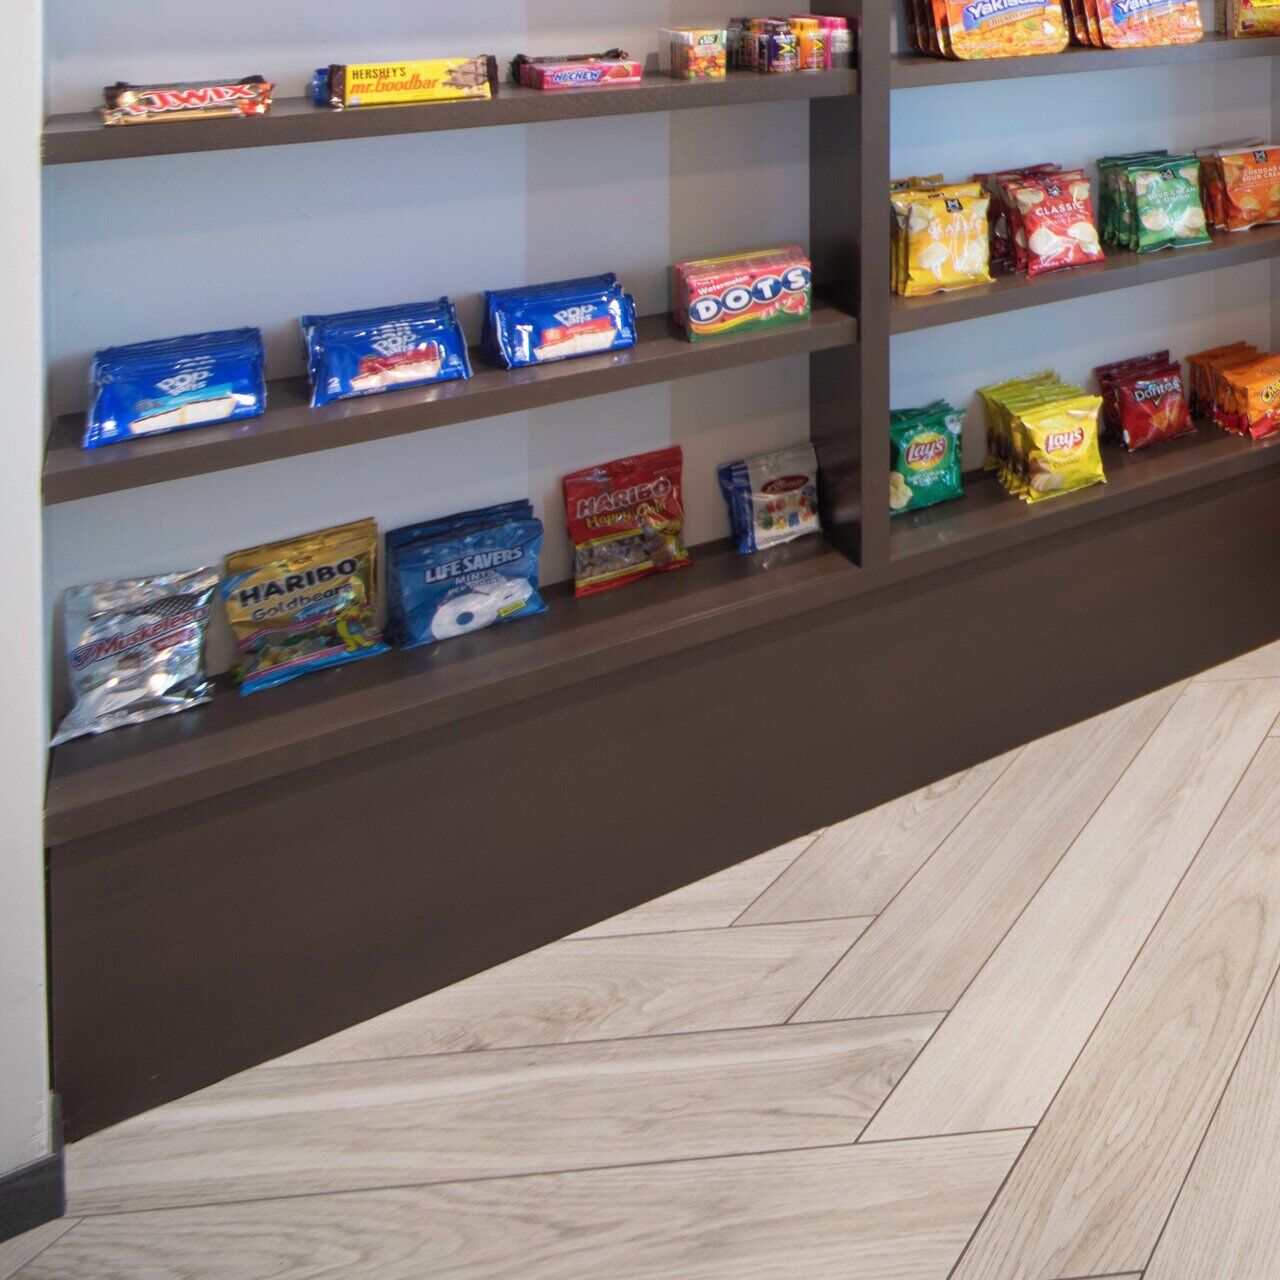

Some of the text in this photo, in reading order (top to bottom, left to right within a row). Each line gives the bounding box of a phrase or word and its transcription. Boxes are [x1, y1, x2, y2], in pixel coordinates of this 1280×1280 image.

[351, 66, 406, 80] HERSHEY'S
[552, 69, 601, 84] HI-CHEW
[134, 84, 255, 112] TWIX
[1242, 175, 1263, 183] SOUR
[1243, 166, 1277, 176] CHEDDAR
[1035, 200, 1085, 217] CLASSIC
[692, 269, 808, 322] DOTS
[697, 274, 750, 296] Watermelon
[1134, 376, 1182, 402] Doritos
[576, 477, 673, 519] HARIBO
[425, 546, 523, 583] LIFE SAVERS
[239, 558, 360, 608] HARIBO
[252, 583, 353, 621] Goldbears
[93, 606, 208, 659] Musketeers
